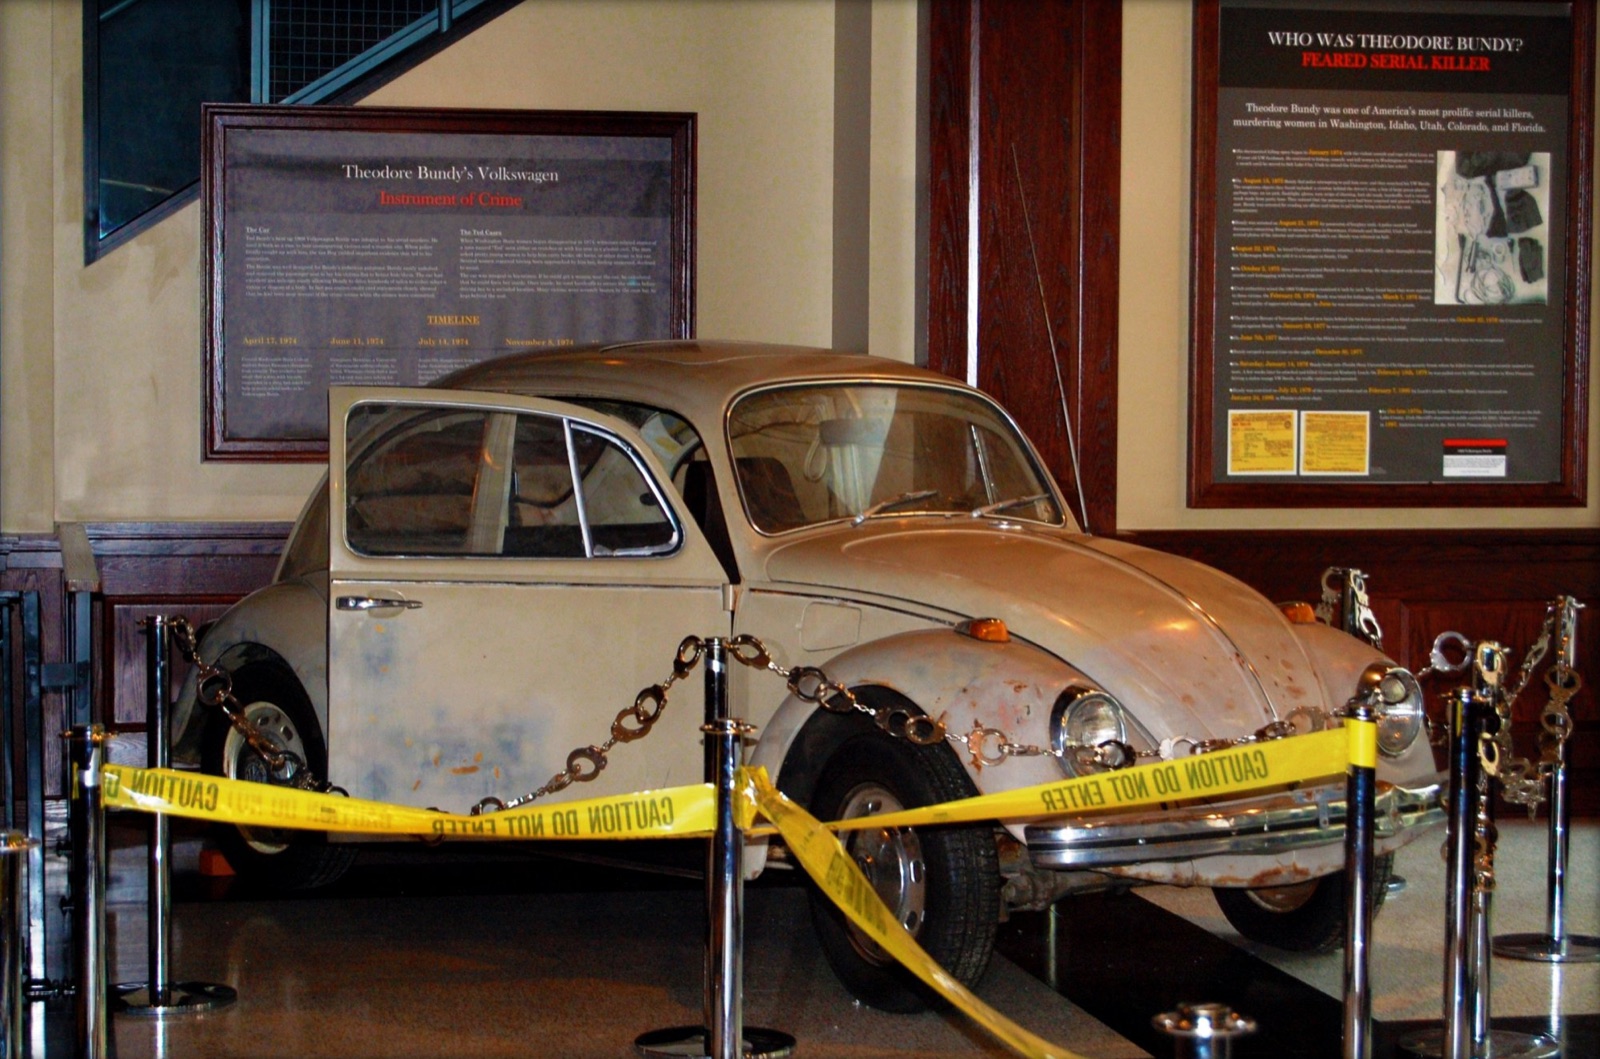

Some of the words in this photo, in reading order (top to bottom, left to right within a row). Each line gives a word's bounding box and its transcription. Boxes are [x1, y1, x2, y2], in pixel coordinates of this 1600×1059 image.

[1268, 32, 1312, 47] WHO
[1317, 32, 1354, 48] WAS
[1358, 34, 1454, 50] THEODORE
[1457, 36, 1523, 52] BUNDY?
[1302, 52, 1367, 68] FEARED
[1370, 54, 1428, 70] SERIAL
[1431, 56, 1491, 72] KILLER
[1246, 103, 1288, 114] Theodore
[1290, 104, 1321, 116] Bundy
[1360, 105, 1371, 115] of
[1372, 106, 1416, 116] America's
[1418, 108, 1440, 117] most
[1442, 107, 1474, 120] prolific
[1475, 108, 1500, 118] serial
[1502, 109, 1534, 120] killers,
[1232, 117, 1281, 129] murdering
[1284, 120, 1316, 128] women
[1318, 119, 1328, 128] in
[1492, 122, 1510, 132] and
[1512, 122, 1546, 133] Florida.
[342, 164, 414, 181] Theodore
[417, 165, 474, 184] Bundy's
[478, 166, 559, 184] Volkswagen
[380, 191, 457, 207] Instrument
[460, 191, 475, 207] of
[478, 192, 522, 208] Crime
[427, 316, 480, 326] TIMELINE
[243, 338, 264, 346] April
[330, 338, 350, 346] June
[366, 338, 384, 346] 1974
[418, 338, 435, 347] July
[506, 338, 545, 346] November
[556, 338, 574, 346] 1974
